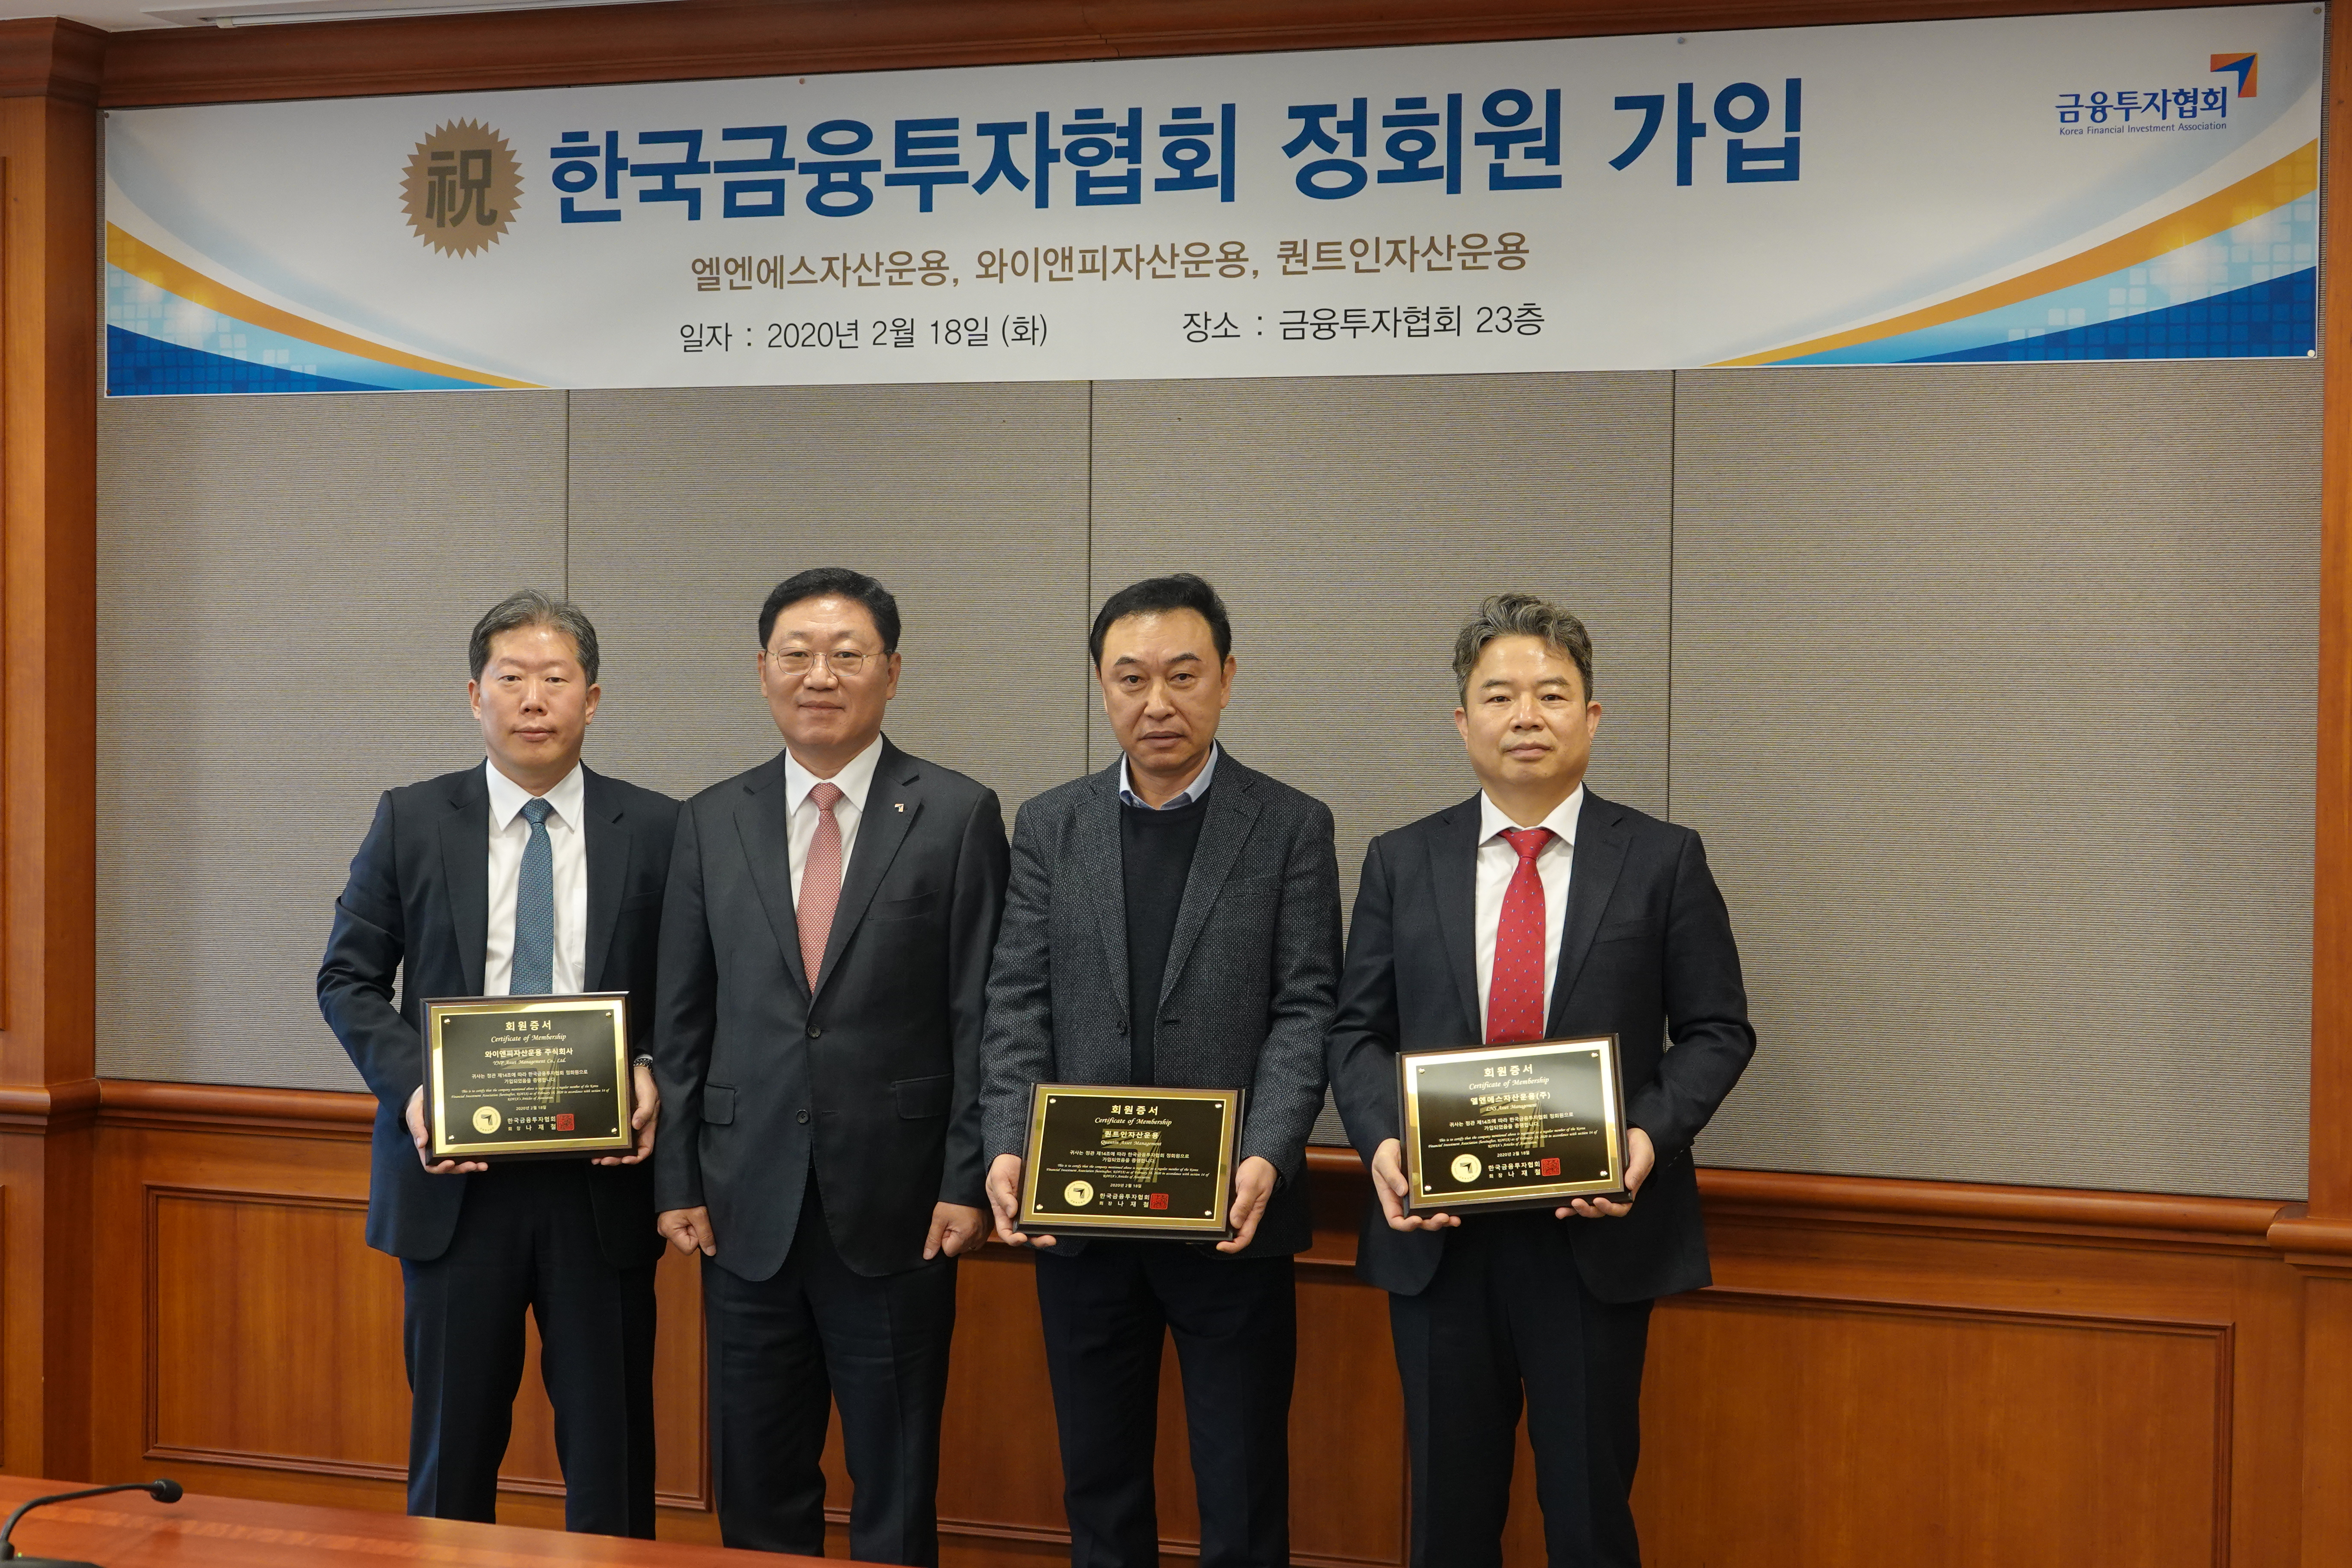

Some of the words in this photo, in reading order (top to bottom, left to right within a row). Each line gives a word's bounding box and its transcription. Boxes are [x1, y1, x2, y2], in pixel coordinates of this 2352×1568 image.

[2055, 86, 2227, 123] 금융투자협회
[2087, 125, 2124, 134] Financial
[2128, 124, 2175, 133] Investment
[2178, 121, 2226, 131] Association
[550, 103, 1236, 224] 한국금융투자협회
[1281, 88, 1562, 200] 정회원
[1608, 78, 1802, 187] 가입
[423, 147, 499, 229] 祝
[691, 250, 959, 292] 엘엔에스자산운용,
[976, 241, 1259, 284] 와이앤피자산운용,
[1277, 232, 1529, 276] 퀀트인자산운용
[1183, 311, 1240, 343] 장소
[1279, 305, 1461, 340] 금융투자협회
[1476, 303, 1545, 336] 23층
[680, 322, 732, 352] 일자
[768, 319, 858, 349] 2020년
[873, 318, 914, 348] 2월
[931, 316, 988, 346] 18일
[1002, 314, 1047, 347] (화)
[505, 1020, 551, 1032] 회원증서
[491, 1035, 521, 1044] Certificate
[523, 1035, 529, 1043] of
[532, 1033, 567, 1042] Membership
[485, 1049, 542, 1058] 와이앤피자산운용
[545, 1047, 573, 1056] 주식회사
[1484, 1064, 1533, 1078] 회원증서
[1469, 1081, 1501, 1091] Certificate
[1503, 1080, 1510, 1088] of
[1512, 1076, 1549, 1087] Membership
[1470, 1091, 1550, 1106] 엘엔에스자산운용(주)
[1111, 1105, 1158, 1115] 회원증서
[507, 1116, 556, 1124] 한국금융투자협회
[1094, 1117, 1126, 1125] Certificate
[1136, 1118, 1172, 1127] Membership
[1104, 1131, 1159, 1139] 퀀트인자산운용
[1488, 1161, 1540, 1171] 한국금융투자협회
